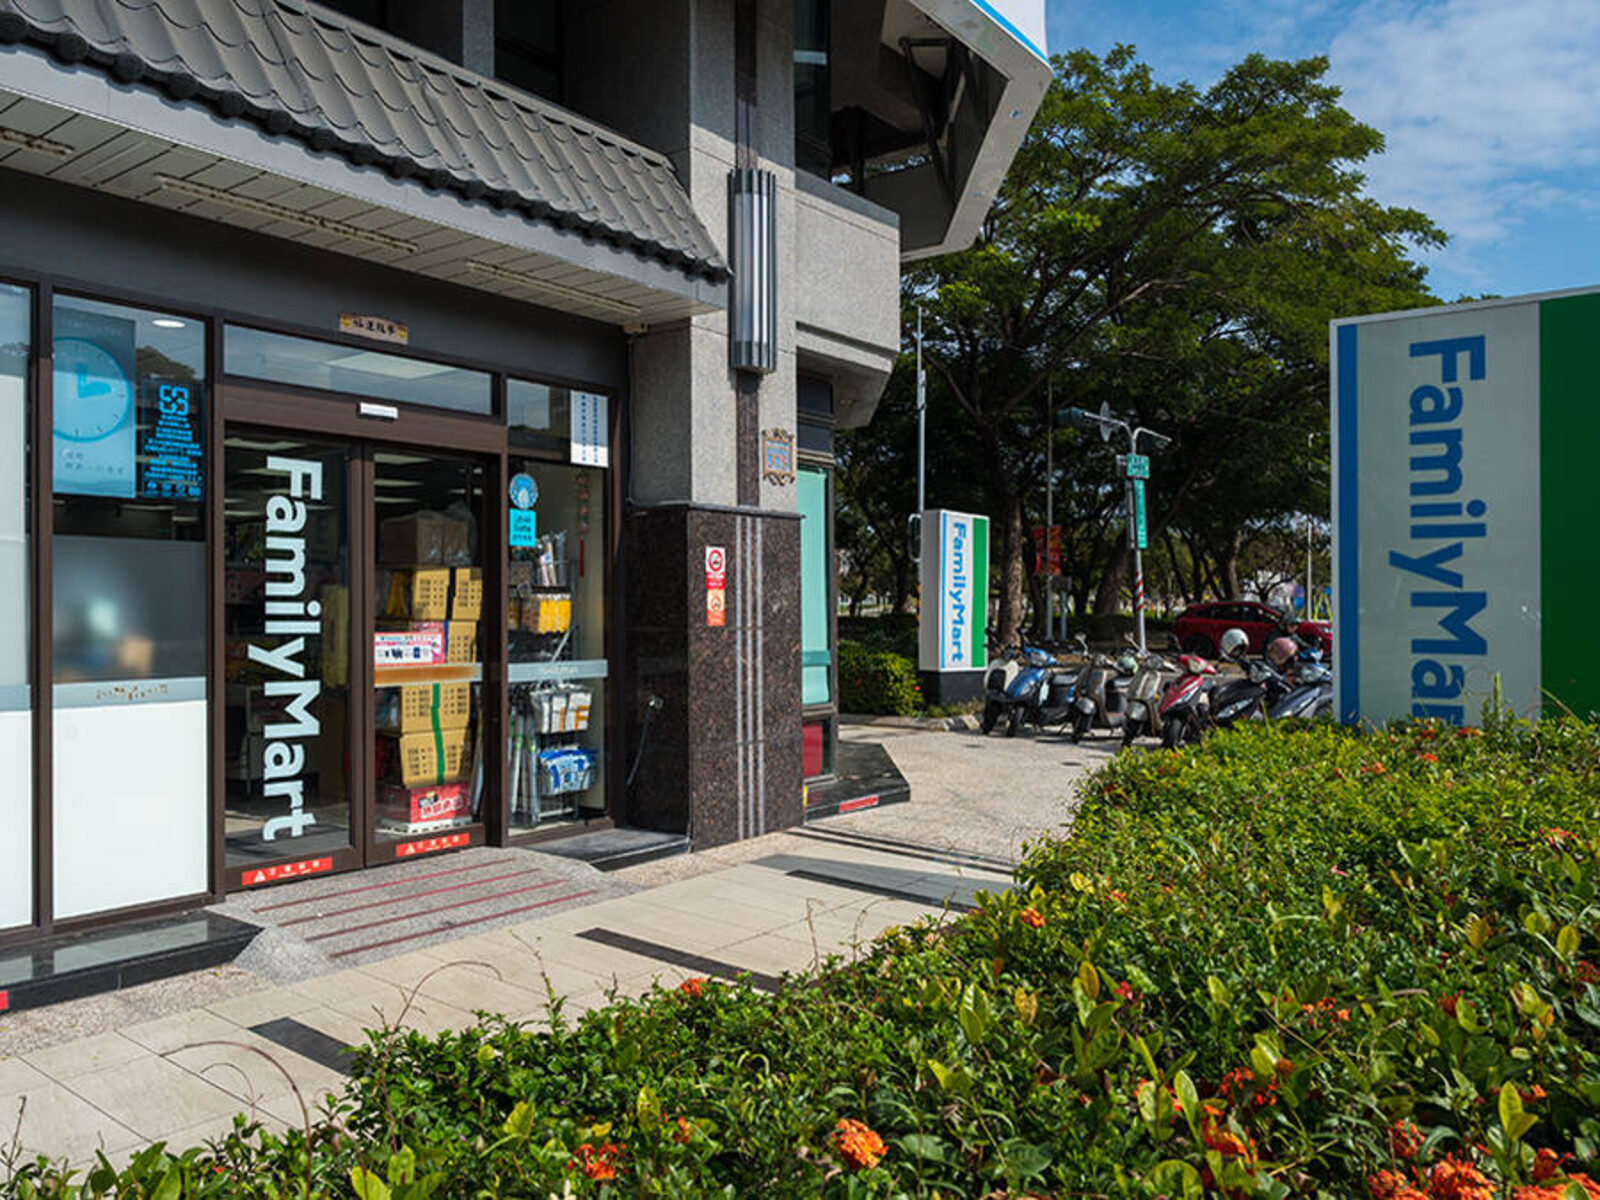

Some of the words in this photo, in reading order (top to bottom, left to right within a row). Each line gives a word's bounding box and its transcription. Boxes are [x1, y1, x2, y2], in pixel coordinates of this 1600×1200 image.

[248, 456, 323, 841] FamilyMart
[949, 521, 967, 662] FamilyMart
[1389, 334, 1488, 728] FamilyMar
